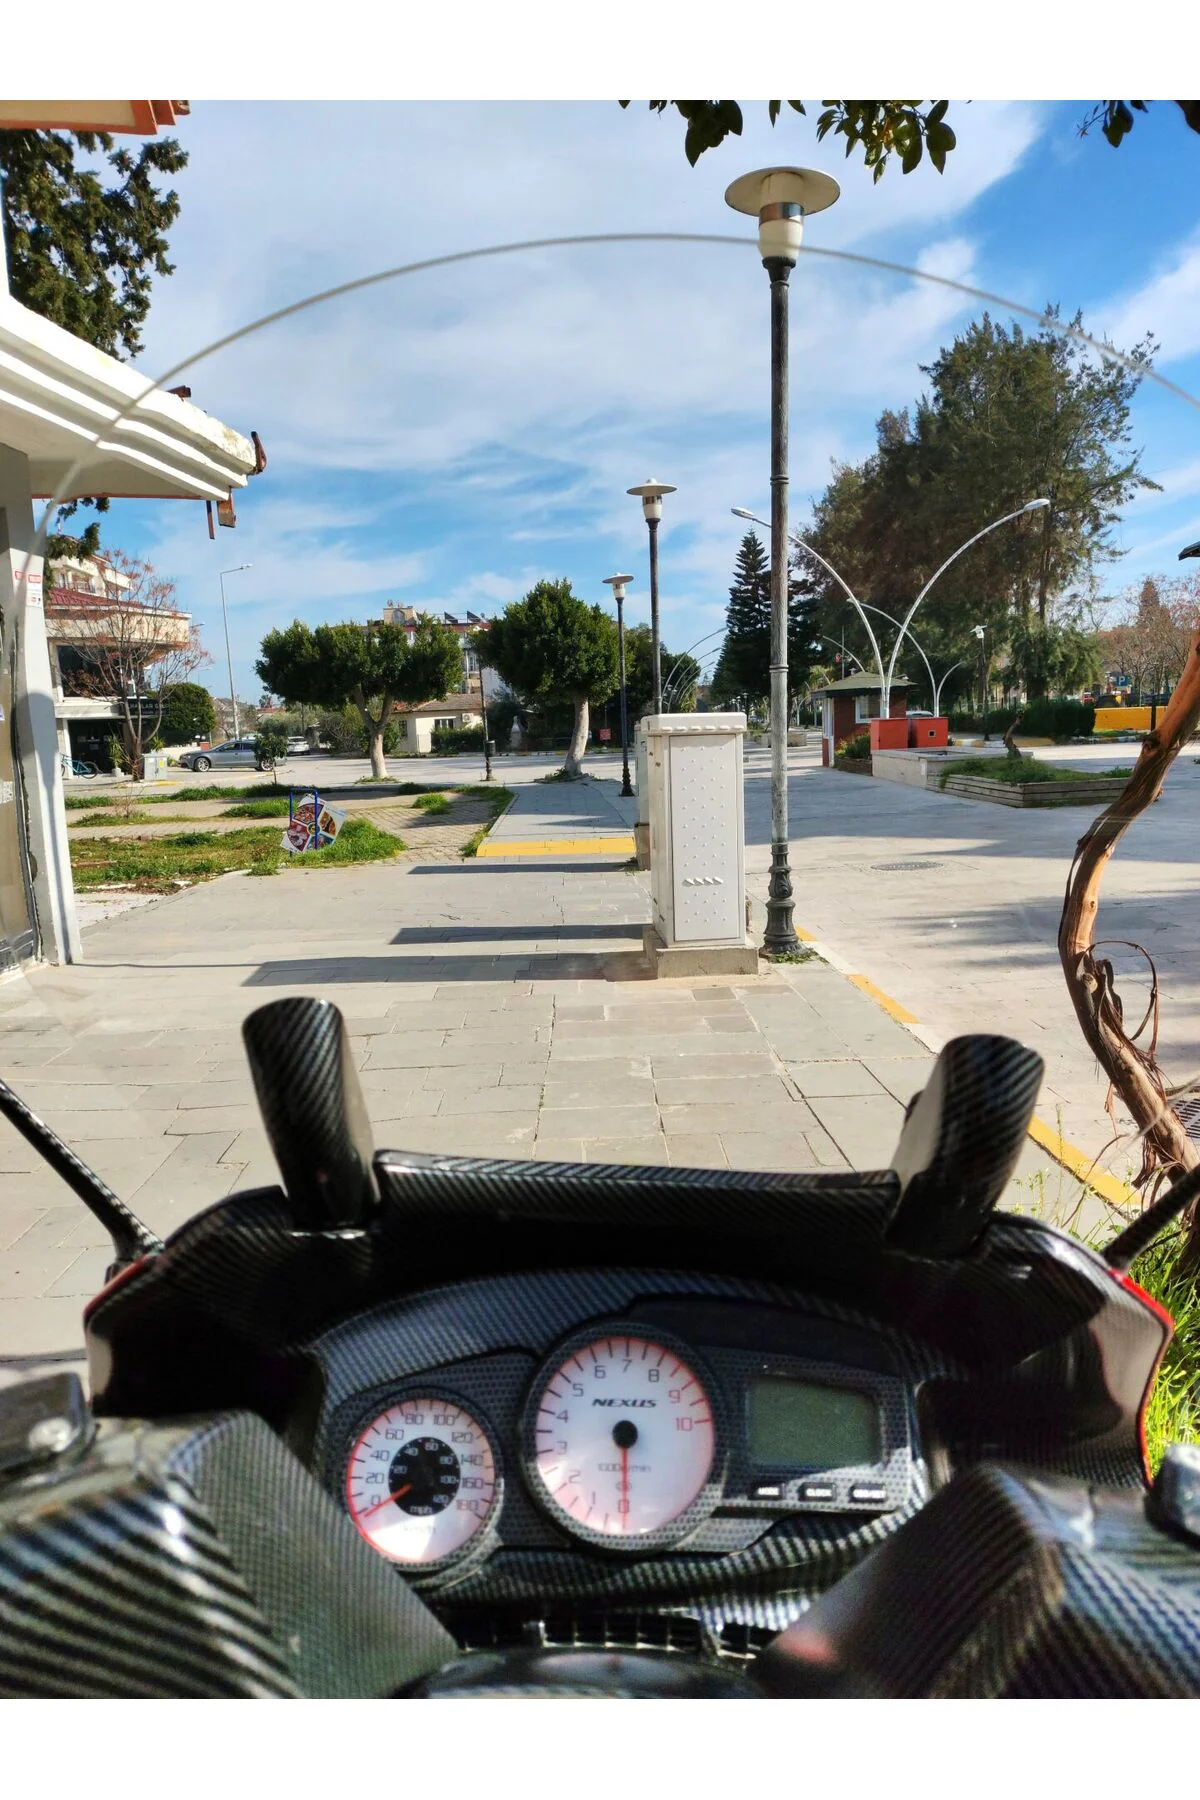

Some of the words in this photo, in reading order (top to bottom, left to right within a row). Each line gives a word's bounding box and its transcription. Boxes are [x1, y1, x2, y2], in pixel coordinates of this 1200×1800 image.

[594, 1365, 606, 1379] 6
[622, 1359, 632, 1373] 7
[648, 1368, 660, 1382] 8
[572, 1383, 585, 1397] 5
[668, 1389, 681, 1403] 9
[592, 1398, 656, 1407] NEXUS
[405, 1413, 424, 1425] 80
[433, 1413, 456, 1425] 100
[556, 1409, 569, 1423] 4
[675, 1417, 693, 1431] 10
[385, 1428, 405, 1441] 60
[451, 1431, 473, 1443] 120
[556, 1440, 567, 1455] 3
[370, 1450, 390, 1461] 40
[461, 1453, 484, 1466] 140
[365, 1472, 385, 1484] 20
[569, 1469, 581, 1483] 2
[462, 1477, 484, 1489] 160
[371, 1495, 381, 1506] 0
[456, 1500, 480, 1513] 180
[617, 1499, 630, 1513] 0
